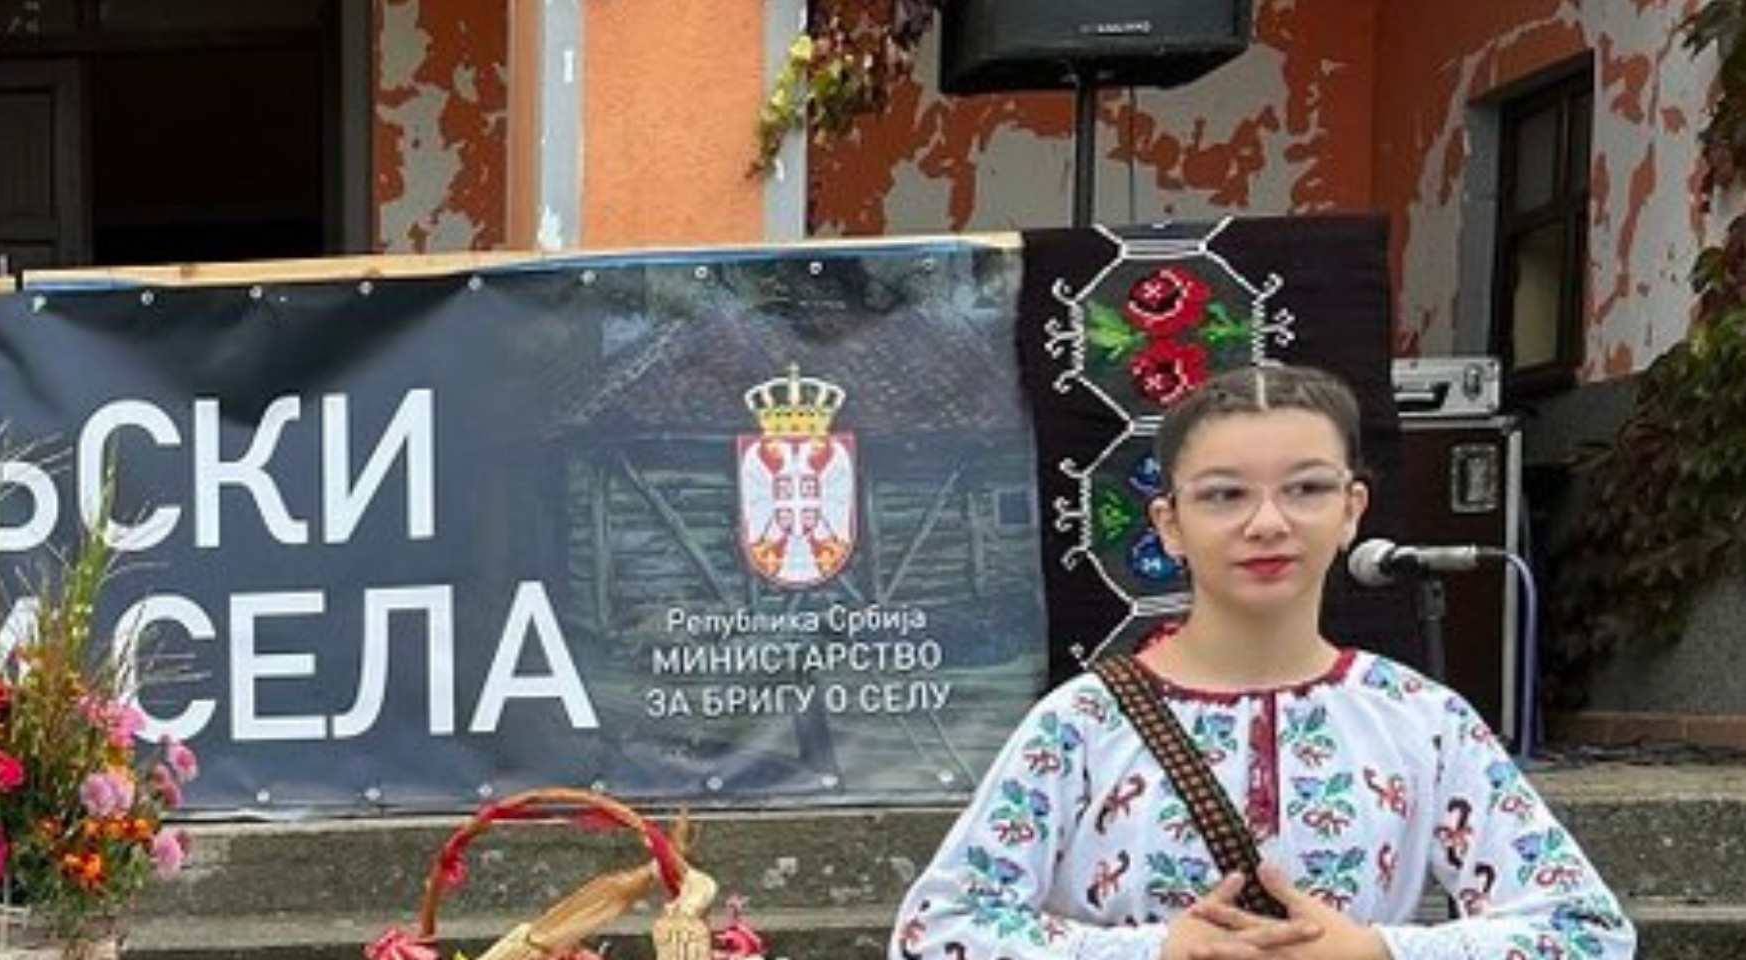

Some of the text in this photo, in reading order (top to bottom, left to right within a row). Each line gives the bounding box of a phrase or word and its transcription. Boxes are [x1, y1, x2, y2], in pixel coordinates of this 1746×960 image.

[667, 603, 927, 639] Република Србија
[112, 580, 600, 744] СЕЛА
[654, 640, 943, 674] МИНИСТАРСТВО
[645, 681, 951, 717] ЗА БРИГУ О СЕЛУ
